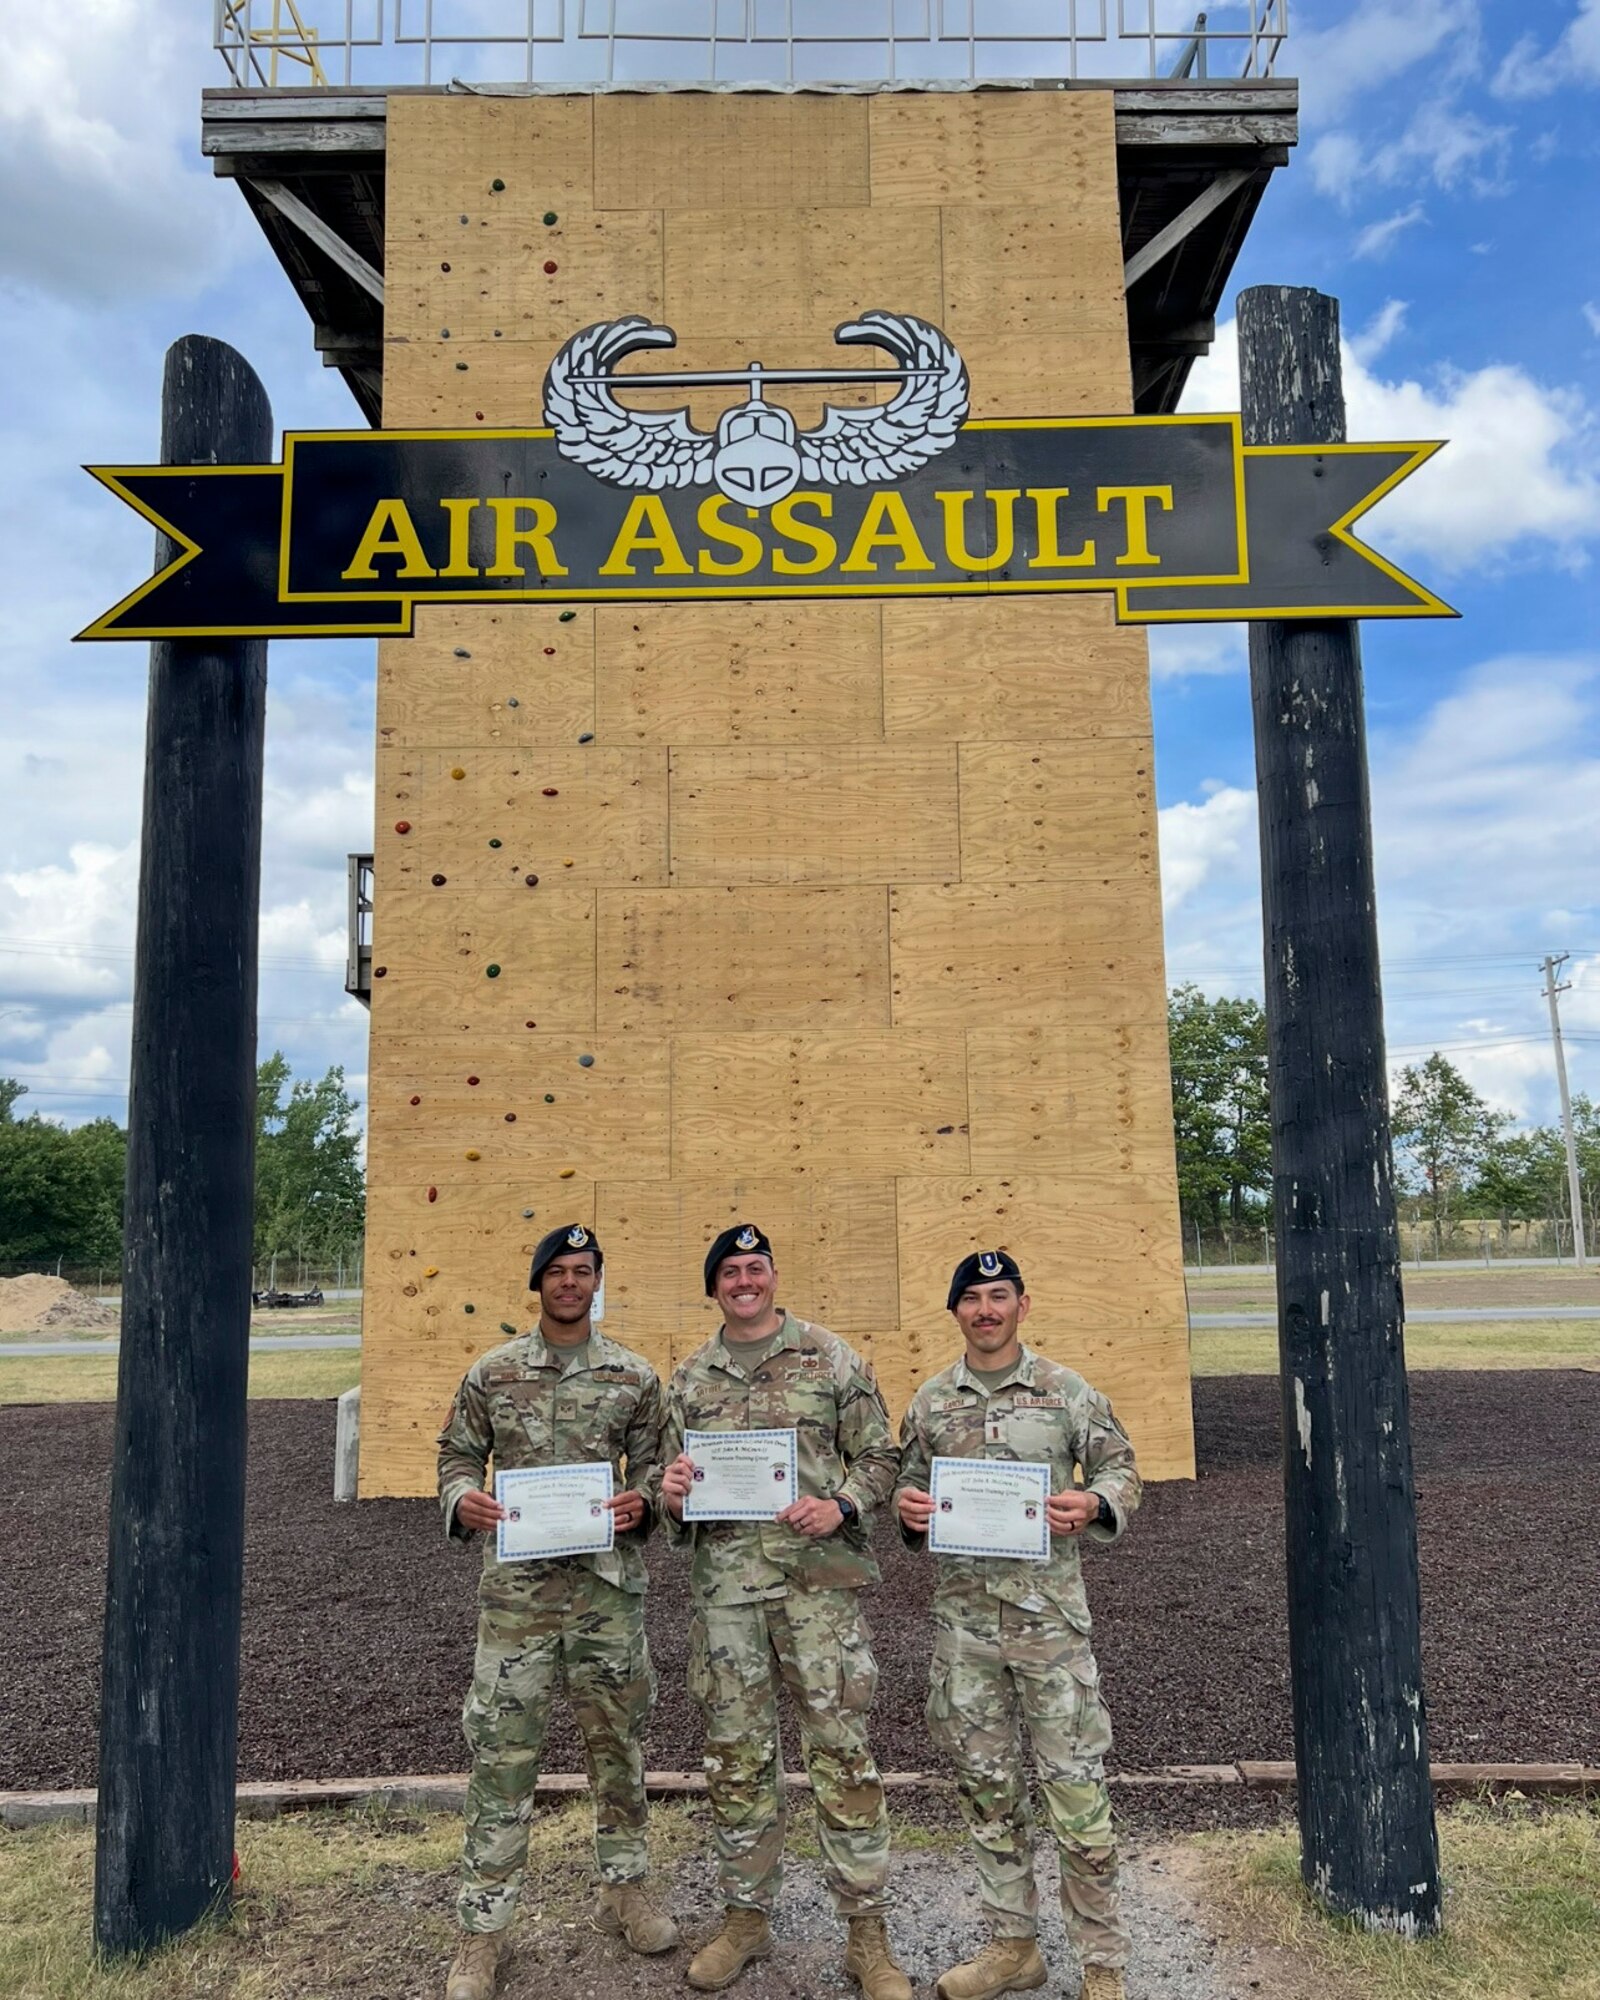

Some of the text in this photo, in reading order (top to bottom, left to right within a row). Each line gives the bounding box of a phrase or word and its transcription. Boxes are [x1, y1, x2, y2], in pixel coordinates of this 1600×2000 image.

[341, 484, 1174, 580] AIR ASSAULT
[1042, 1398, 1062, 1406] FORCE
